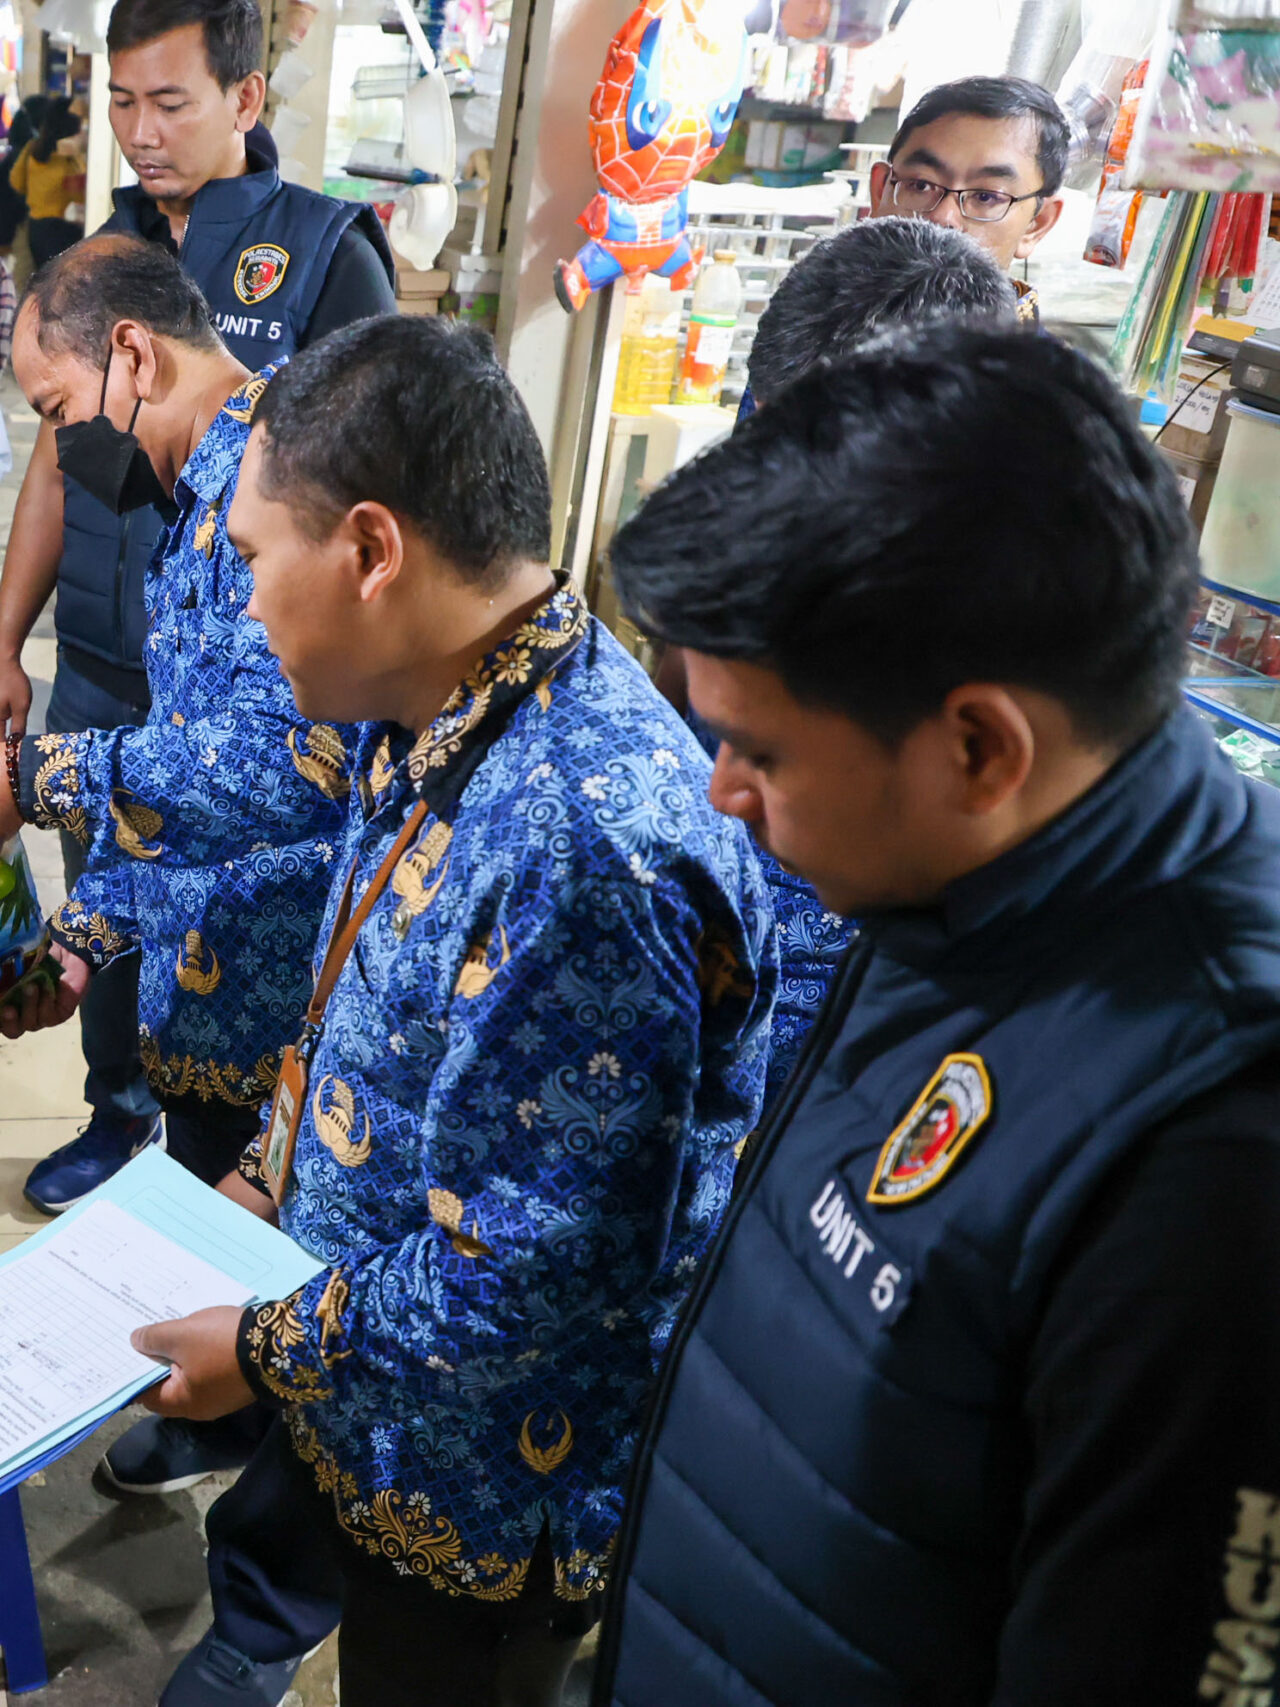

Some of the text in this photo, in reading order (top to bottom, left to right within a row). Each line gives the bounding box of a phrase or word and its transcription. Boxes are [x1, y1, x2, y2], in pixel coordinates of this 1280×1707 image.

[216, 313, 282, 340] UNIT 5
[809, 1181, 902, 1312] UNIT 5
